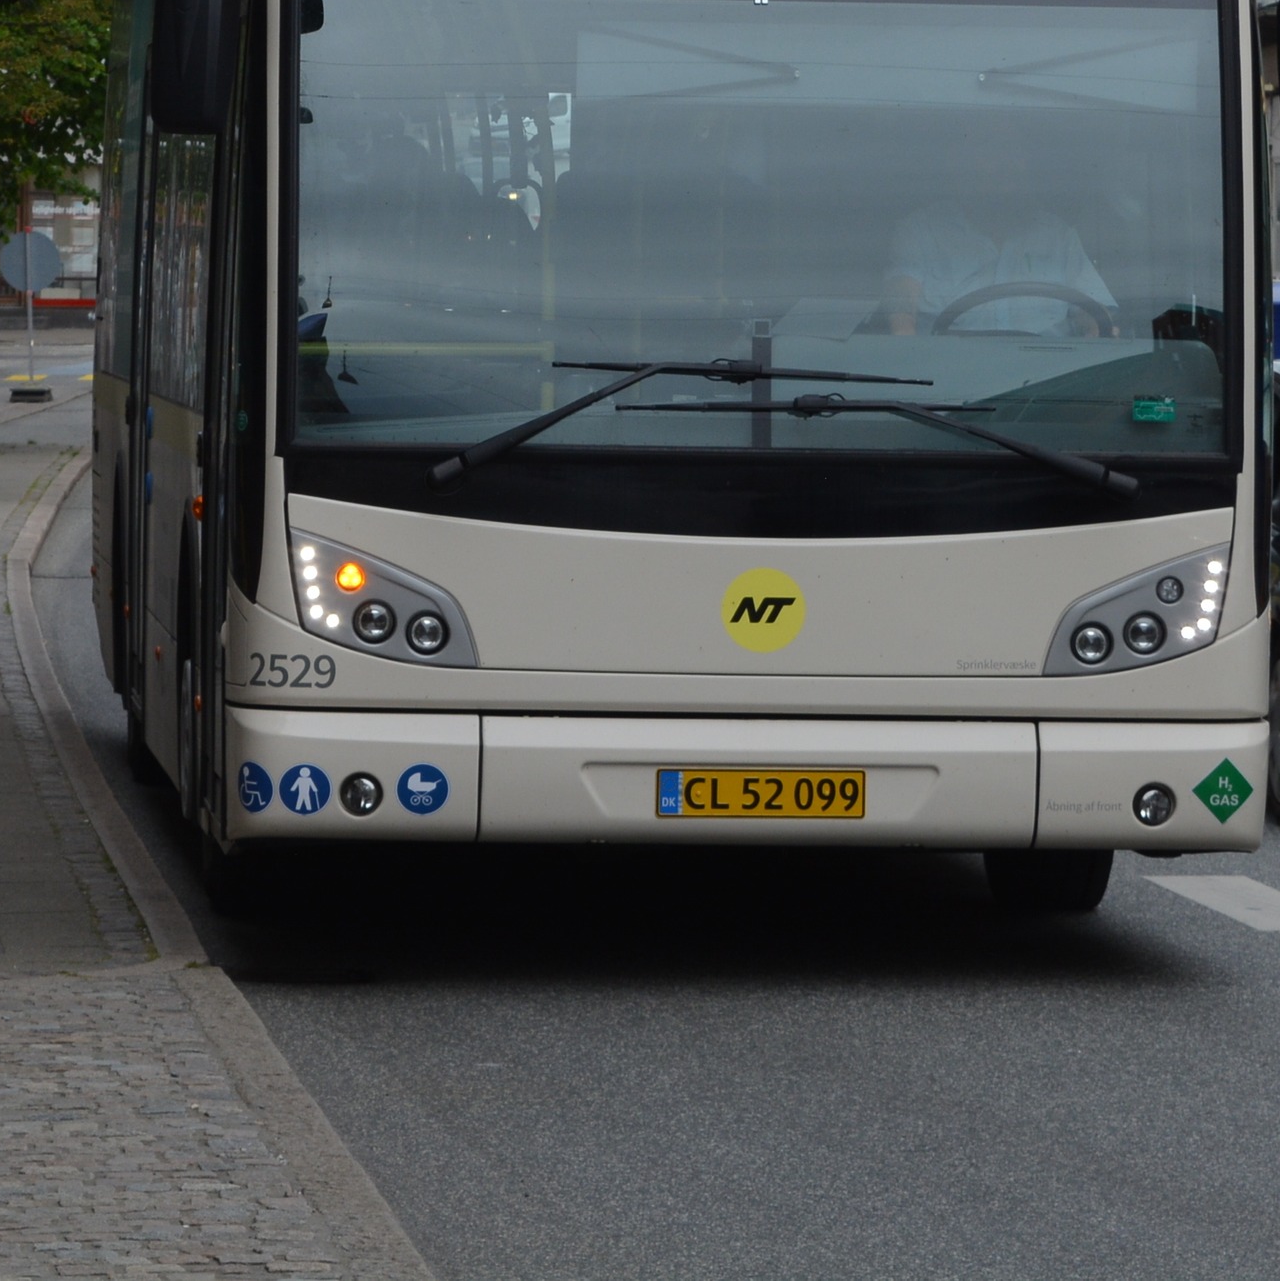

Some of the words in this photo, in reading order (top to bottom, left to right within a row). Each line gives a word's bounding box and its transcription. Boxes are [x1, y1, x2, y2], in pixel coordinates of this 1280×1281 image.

[729, 596, 797, 623] NT
[249, 652, 336, 689] 2529
[956, 659, 1036, 671] Sprinklervæske
[684, 777, 730, 810] CL
[741, 777, 784, 810] 52
[793, 777, 859, 812] 099
[1209, 794, 1240, 807] GAS
[661, 796, 677, 807] DK
[1045, 800, 1082, 813] Åbning
[1084, 800, 1095, 812] af
[1096, 800, 1123, 812] front
